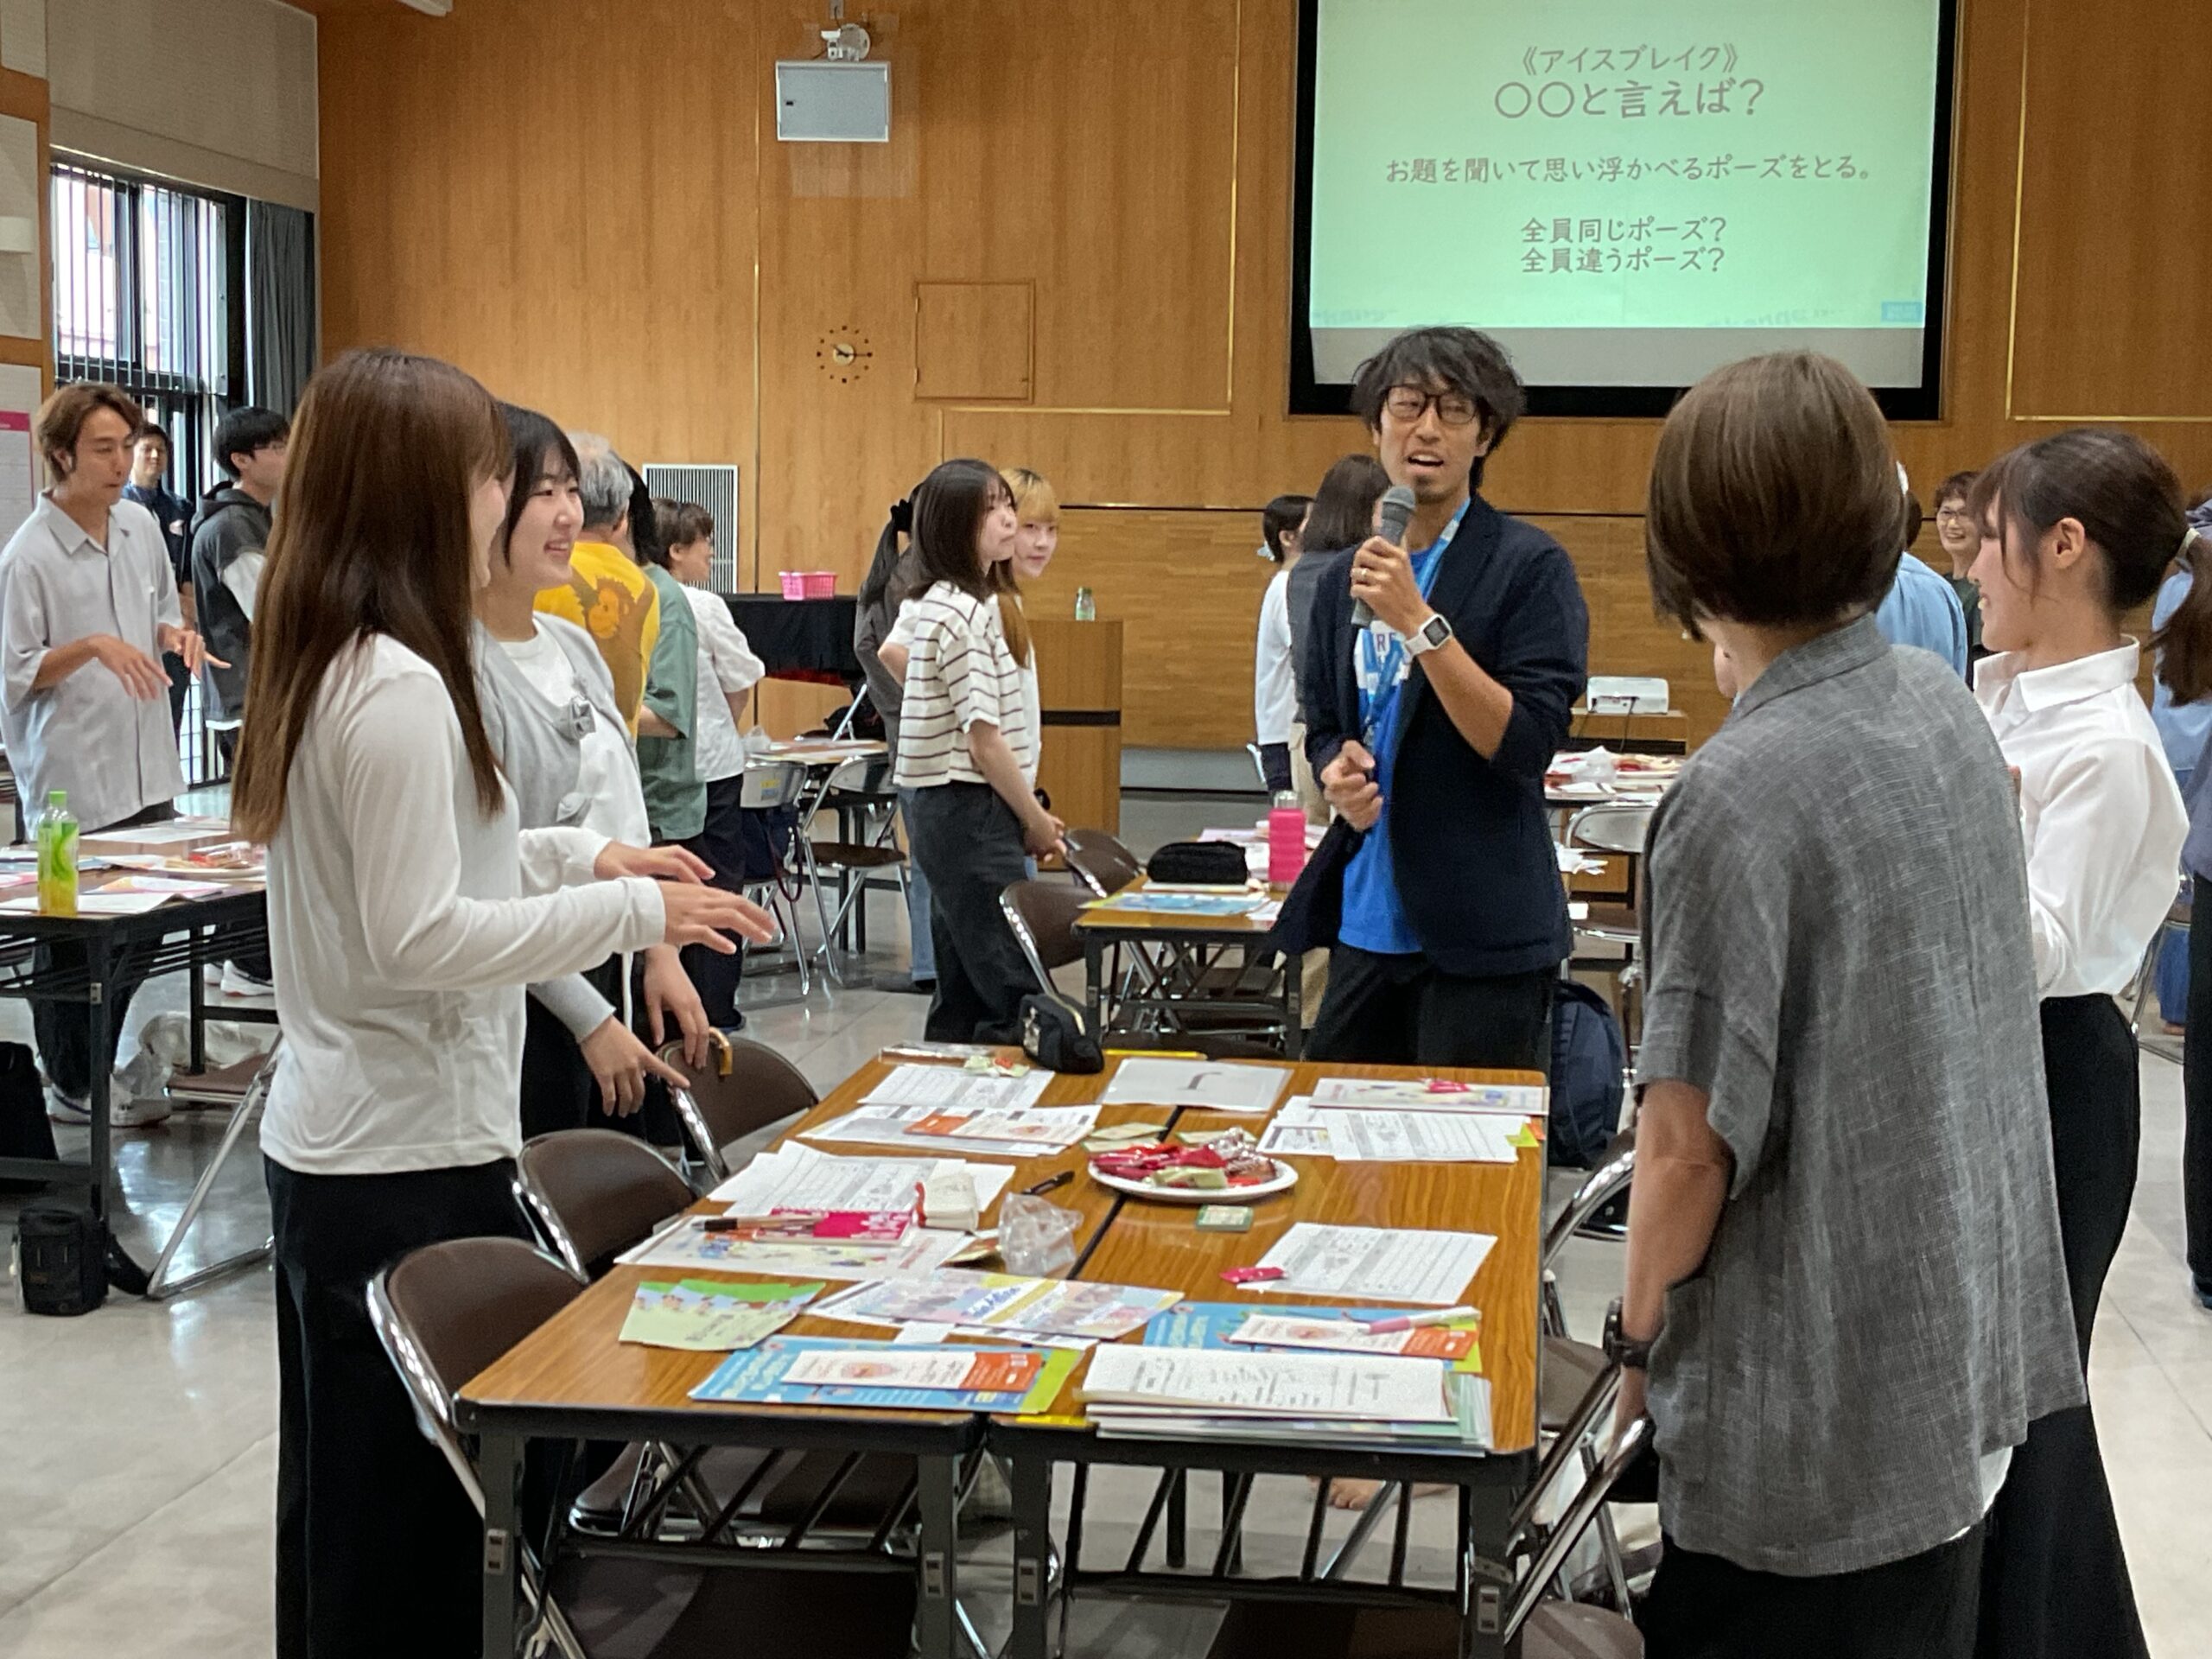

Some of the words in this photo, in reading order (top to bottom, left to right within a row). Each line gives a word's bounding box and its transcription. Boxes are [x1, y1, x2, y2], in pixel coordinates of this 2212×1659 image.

[1386, 154, 1872, 184] お題を聞いて思い浮かべるポーズをとる。
[1520, 216, 1727, 245] 全員同じポーズ？
[1520, 245, 1726, 274] 全員違うポーズ？
